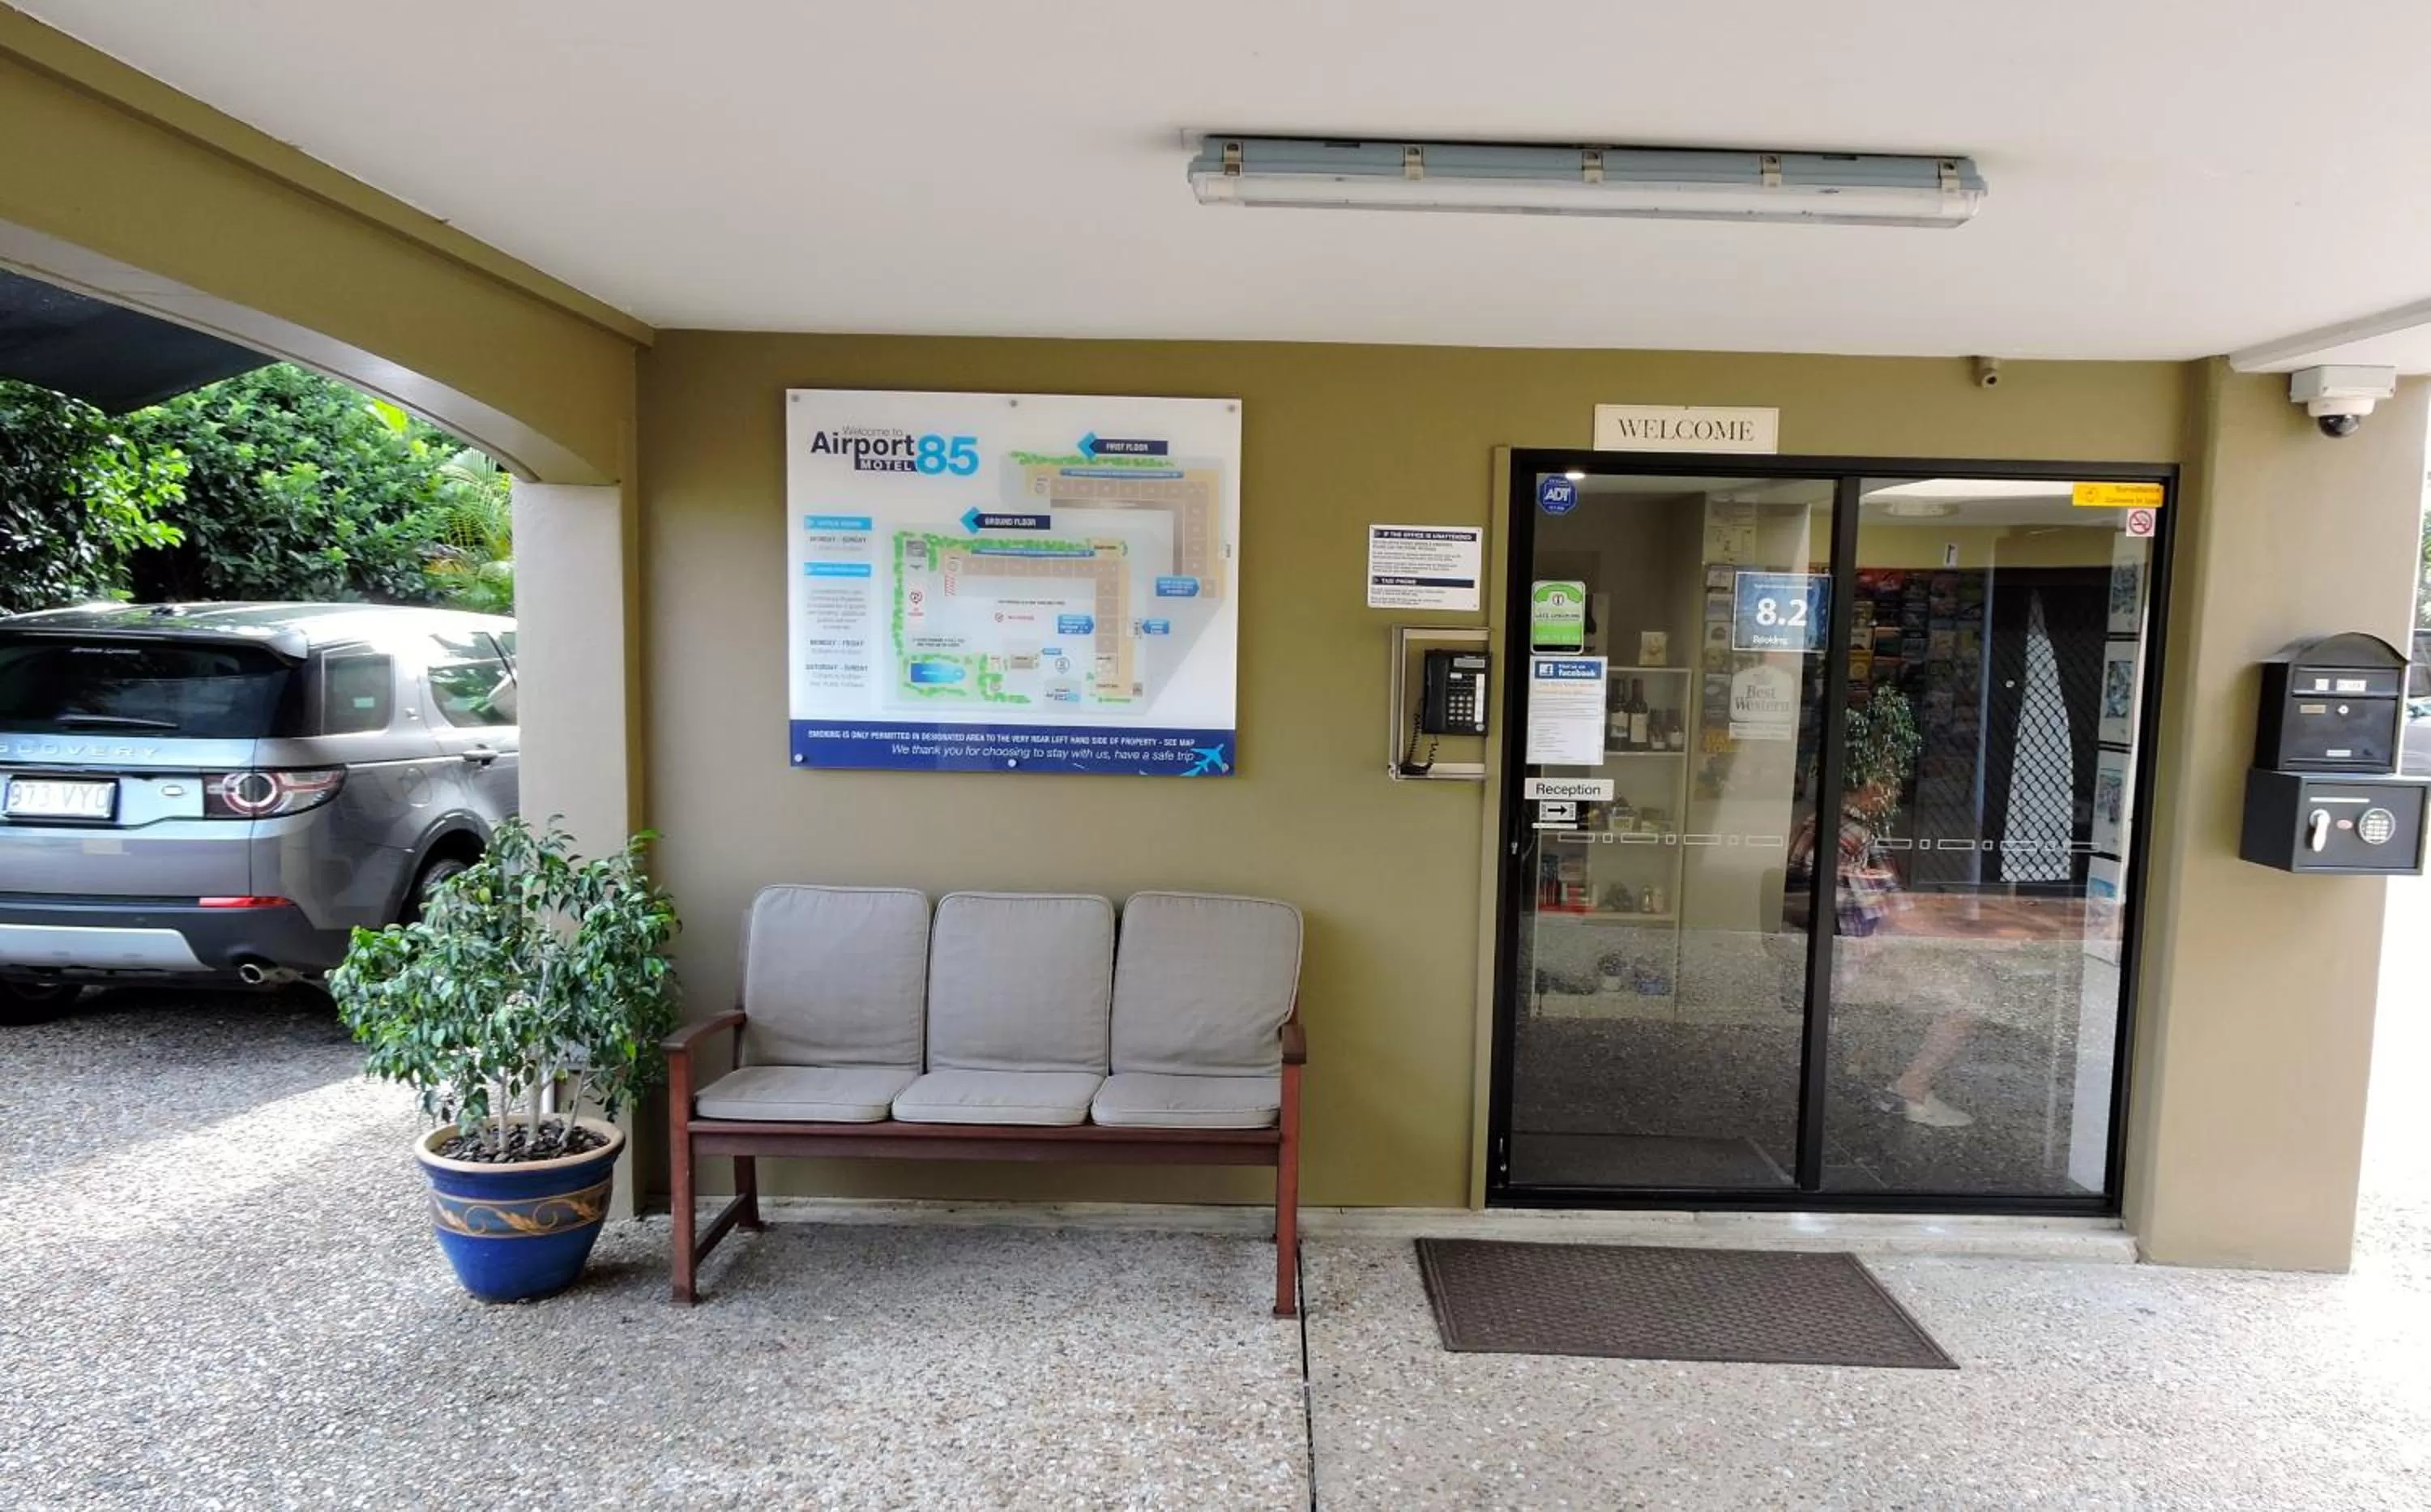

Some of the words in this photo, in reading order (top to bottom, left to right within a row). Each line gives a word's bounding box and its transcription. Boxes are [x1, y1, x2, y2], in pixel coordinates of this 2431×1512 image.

[843, 425, 890, 435] Welcome
[892, 426, 904, 436] to
[1618, 418, 1754, 441] WELCOME
[810, 431, 915, 459] Airport
[1106, 442, 1125, 451] FIRST
[1126, 442, 1148, 451] FLOOR
[916, 434, 980, 476] 85
[860, 460, 912, 471] MOTEL
[1544, 487, 1571, 502] ADT
[985, 515, 1013, 525] GROUND
[1014, 516, 1036, 526] FLOOR
[1756, 597, 1809, 626] 8.2
[1745, 686, 1777, 699] Best
[1734, 697, 1790, 711] Western
[852, 731, 869, 740] ONLY
[871, 731, 910, 740] PERMITTED
[966, 733, 985, 741] AREA
[985, 733, 996, 742] TO
[998, 733, 1010, 743] THE
[1012, 734, 1029, 743] VERY
[1051, 735, 1068, 744] LEFT
[1122, 737, 1157, 746] PROPERTY
[1164, 738, 1177, 746] SEE
[1179, 738, 1194, 747] MAP
[892, 744, 909, 754] We
[912, 744, 940, 755] thank
[943, 747, 963, 758] you
[965, 745, 980, 756] for
[982, 745, 1031, 759] choosing
[1033, 747, 1045, 758] to
[1046, 747, 1068, 759] stay
[1070, 748, 1094, 758] with
[1114, 750, 1140, 759] have
[1151, 750, 1174, 760] safe
[1177, 751, 1194, 763] trip
[1535, 783, 1601, 797] Reception
